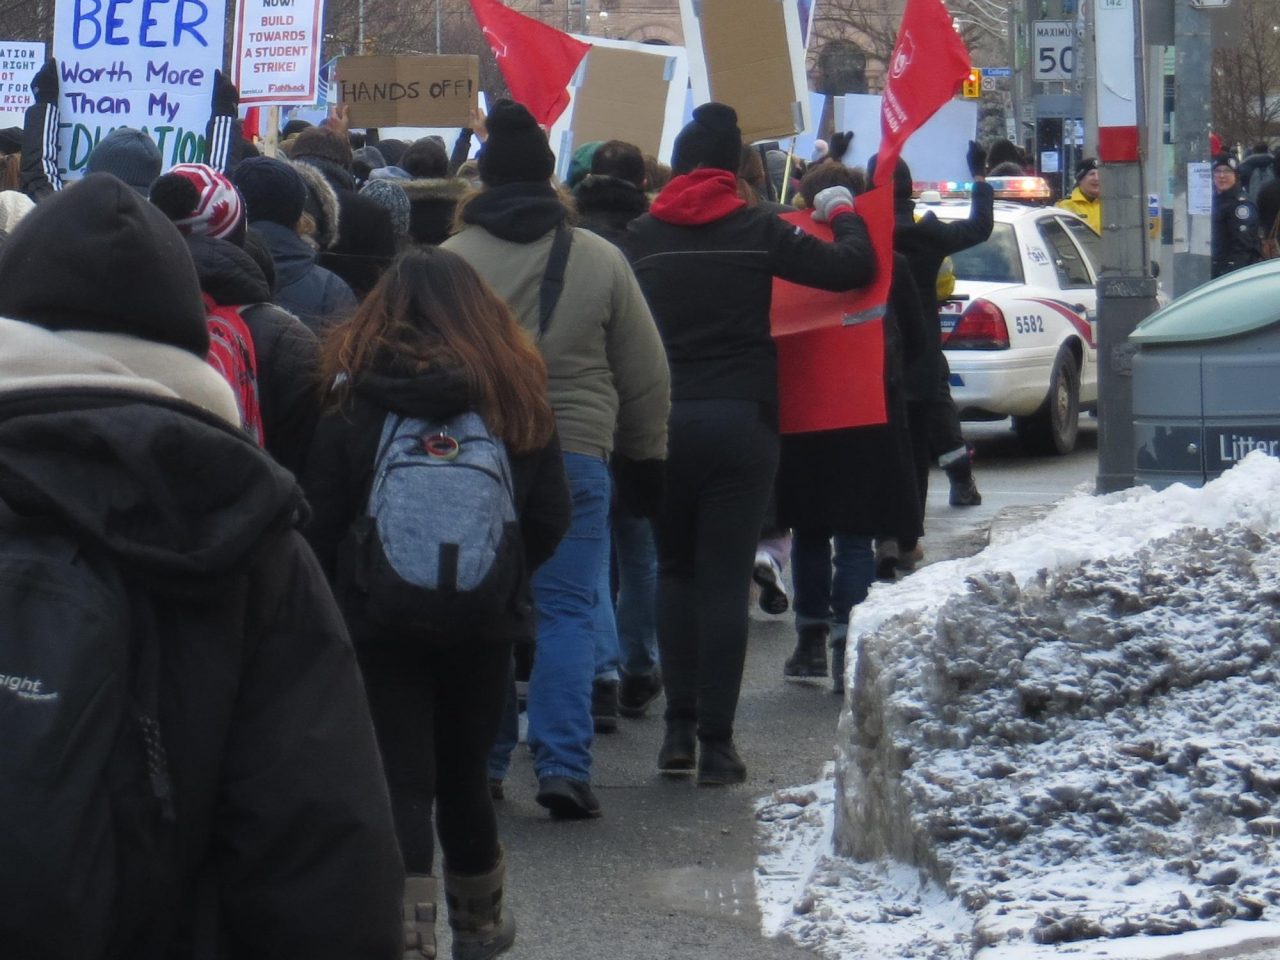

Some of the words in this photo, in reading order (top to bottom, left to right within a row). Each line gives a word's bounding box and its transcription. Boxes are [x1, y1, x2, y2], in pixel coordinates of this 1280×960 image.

[261, 15, 294, 27] BUILD
[249, 30, 306, 42] TOWARDS
[1036, 27, 1072, 37] MAXIMU
[244, 48, 252, 58] A
[255, 46, 308, 58] STUDENT
[2, 61, 36, 70] RIGHT
[253, 62, 296, 74] STRIKE!
[60, 60, 133, 84] Worth
[145, 60, 204, 86] More
[8, 83, 29, 93] FOR
[339, 80, 419, 103] HANDS
[429, 79, 473, 99] OFF!
[4, 95, 31, 104] RICH
[65, 92, 131, 114] Than
[148, 91, 181, 123] My
[1015, 315, 1044, 334] 5582
[1220, 434, 1279, 461] Litter
